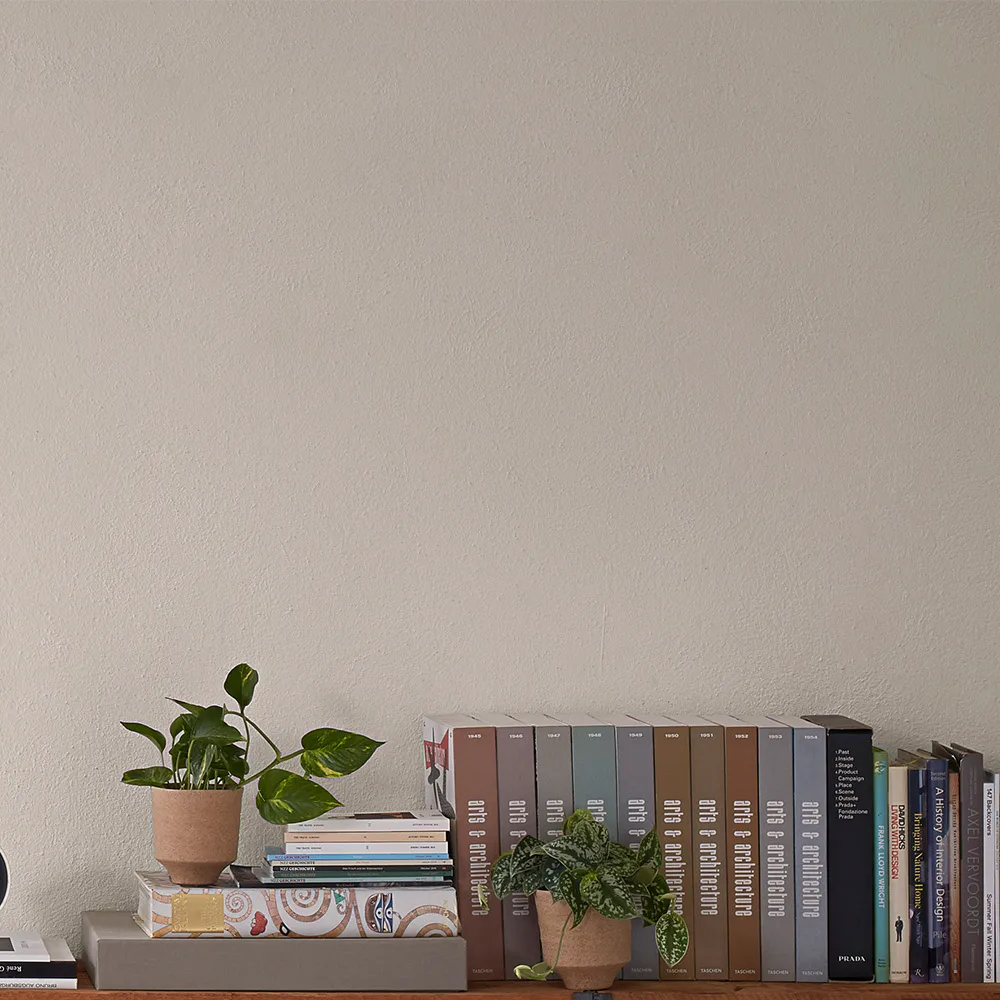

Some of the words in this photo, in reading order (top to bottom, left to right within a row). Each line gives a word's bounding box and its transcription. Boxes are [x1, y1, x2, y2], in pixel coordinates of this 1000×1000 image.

[935, 787, 944, 795] A
[468, 800, 486, 823] arts
[509, 800, 528, 823] arts
[547, 800, 564, 822] arts
[628, 800, 647, 822] arts
[664, 800, 683, 822] arts
[699, 800, 718, 822] arts
[733, 800, 753, 823] arts
[767, 801, 786, 824] arts
[802, 801, 821, 825] arts
[933, 798, 944, 832] History
[469, 830, 485, 838] &
[700, 829, 716, 837] &
[767, 831, 784, 839] &
[912, 813, 923, 850] Bringing
[967, 808, 978, 841] AXEL
[935, 836, 944, 846] of
[914, 852, 923, 882] Nature
[936, 850, 944, 884] Interior
[700, 843, 720, 915] architecture
[734, 844, 755, 916] architecture
[767, 844, 788, 917] architecture
[802, 845, 823, 918] architecture
[914, 884, 923, 909] Home
[967, 847, 979, 936] VERVOORDT
[934, 888, 945, 922] Design
[6, 964, 22, 972] René
[984, 958, 993, 979] Spring
